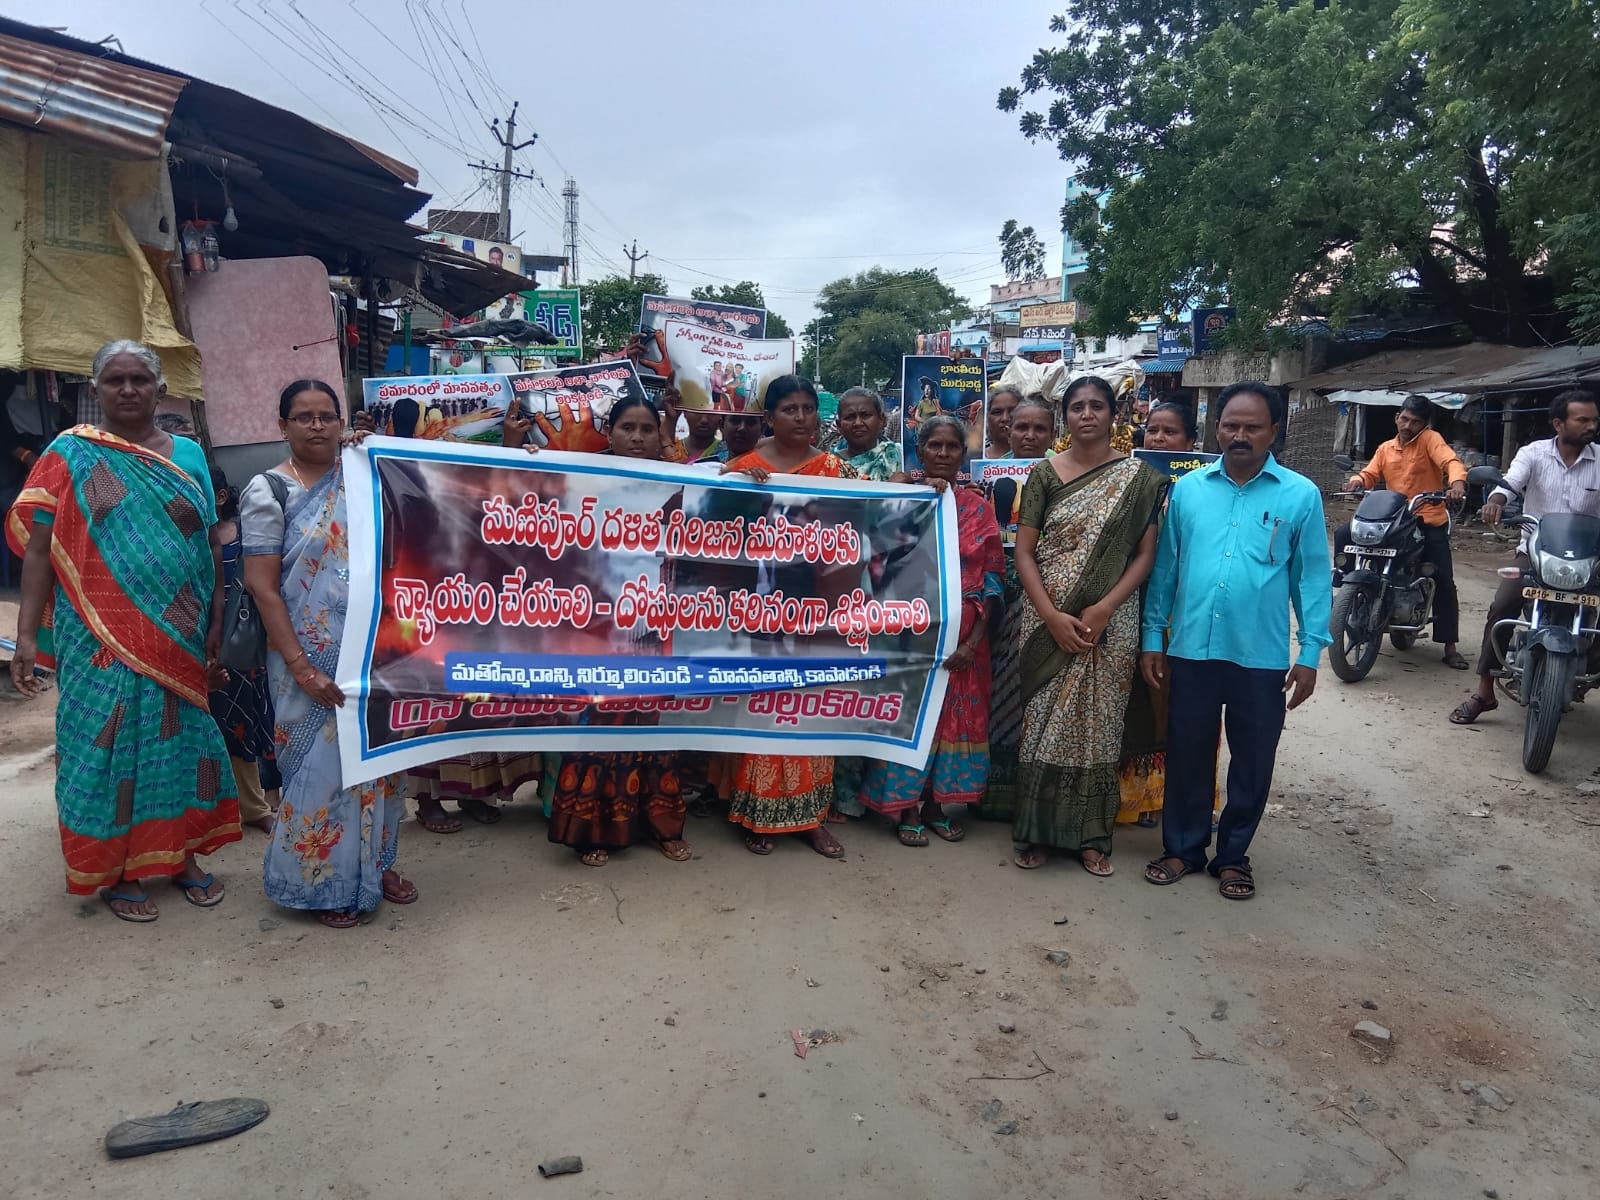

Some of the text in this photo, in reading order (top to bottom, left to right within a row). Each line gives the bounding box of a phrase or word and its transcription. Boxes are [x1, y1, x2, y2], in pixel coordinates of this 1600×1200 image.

[379, 380, 502, 400] ప్రమాదంలో మానవత్వం
[481, 491, 861, 565] మణిపూర్ దళిత గిరిజన మహిళలకు
[394, 573, 497, 645] న్యాయం
[499, 565, 593, 629] చేయాలి
[614, 573, 726, 642] దోషులను
[829, 588, 932, 654] శిక్షించాలి
[452, 660, 576, 688] మతోన్మాదాన్ని
[577, 664, 691, 689] నిర్మూలించండి
[805, 664, 882, 683] కాపాడండి
